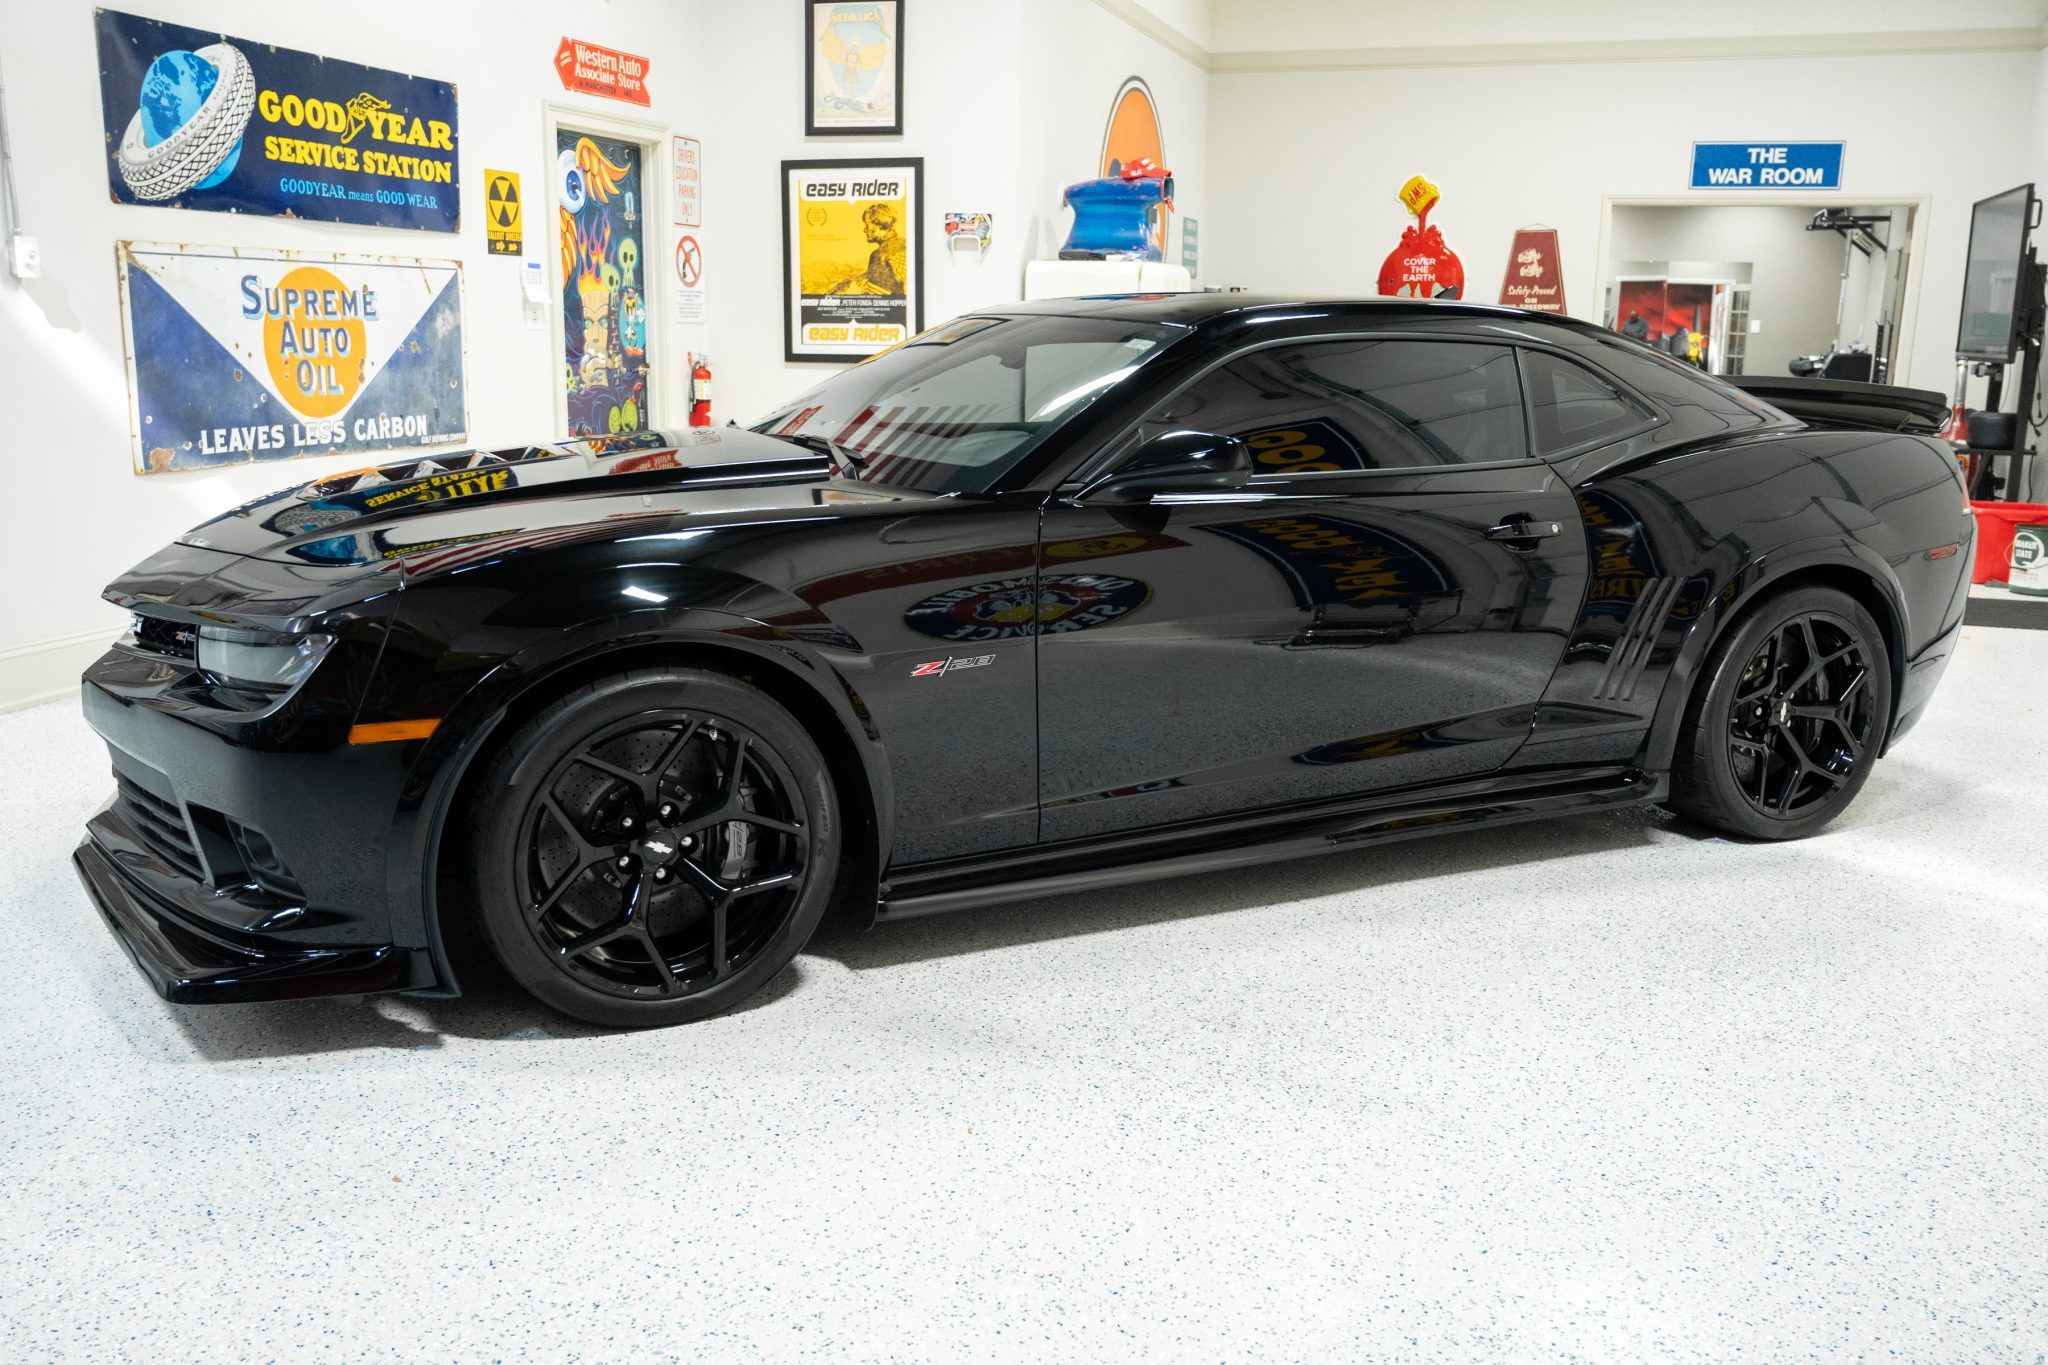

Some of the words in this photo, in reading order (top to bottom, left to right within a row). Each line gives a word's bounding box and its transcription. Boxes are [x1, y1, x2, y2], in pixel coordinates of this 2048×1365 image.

[575, 43, 617, 72] Western
[619, 55, 641, 78] Auto
[574, 62, 615, 85] Associate
[618, 73, 641, 91] Store
[147, 105, 210, 158] GOODYEAR
[264, 135, 360, 172] SERVICE
[362, 152, 452, 183] STATION
[1747, 147, 1788, 165] THE
[1707, 167, 1753, 185] WAR
[1759, 167, 1824, 185] ROOM
[279, 177, 347, 200] GOODYEAR
[348, 189, 374, 203] means
[375, 189, 406, 206] GOOD
[406, 192, 438, 209] WEAR
[806, 181, 847, 198] easy
[1408, 182, 1428, 206] SWP
[1403, 257, 1437, 267] COVER
[1410, 265, 1430, 274] THE
[1402, 273, 1436, 282] EARTH
[240, 275, 379, 321] SUPREME
[280, 321, 351, 358] AUTO
[808, 327, 848, 343] easy
[296, 359, 344, 396] OIL
[201, 424, 286, 455] LEAVES
[294, 420, 346, 447] LESS
[354, 414, 428, 441] CARBON
[2015, 549, 2033, 559] STATE
